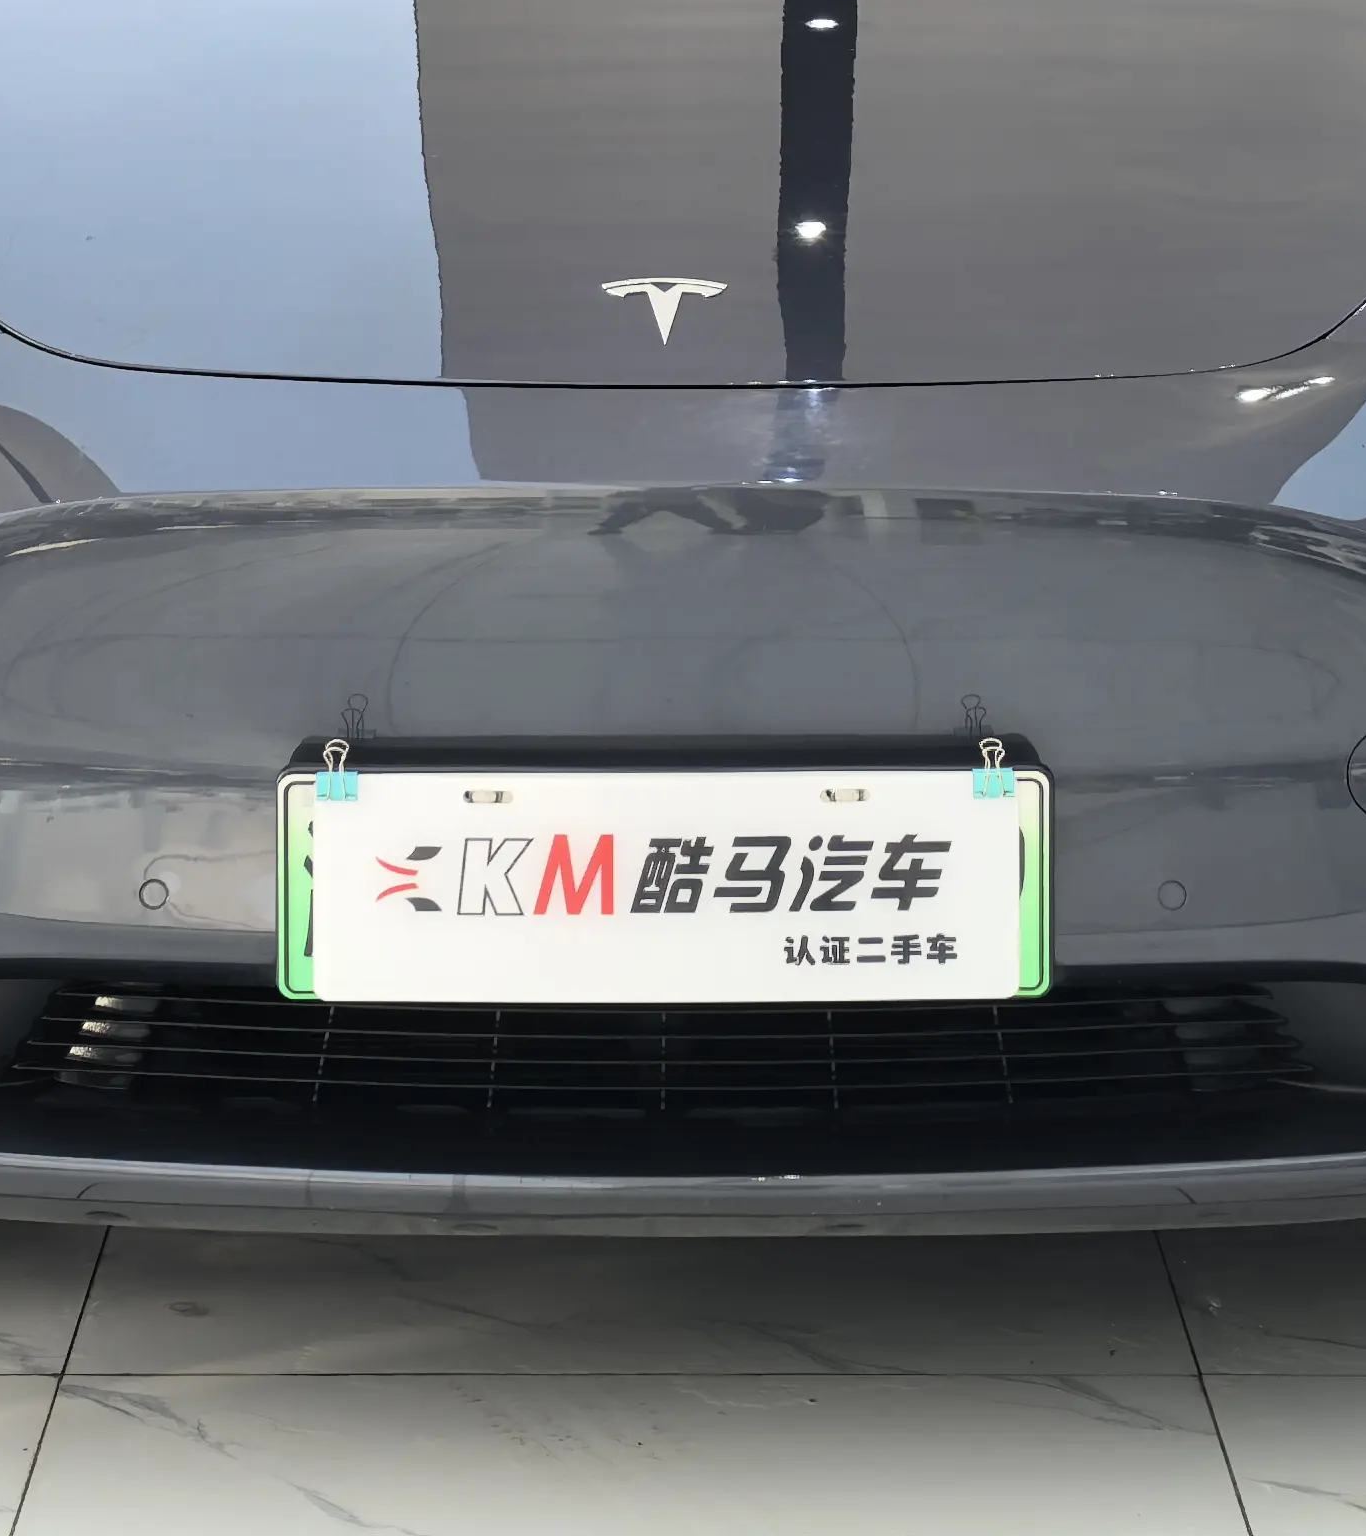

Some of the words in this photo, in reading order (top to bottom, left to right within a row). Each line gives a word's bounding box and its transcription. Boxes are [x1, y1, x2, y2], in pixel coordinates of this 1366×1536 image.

[456, 833, 615, 916] KM
[629, 833, 953, 914] 酷马汽车
[783, 932, 958, 966] 认证二手车
